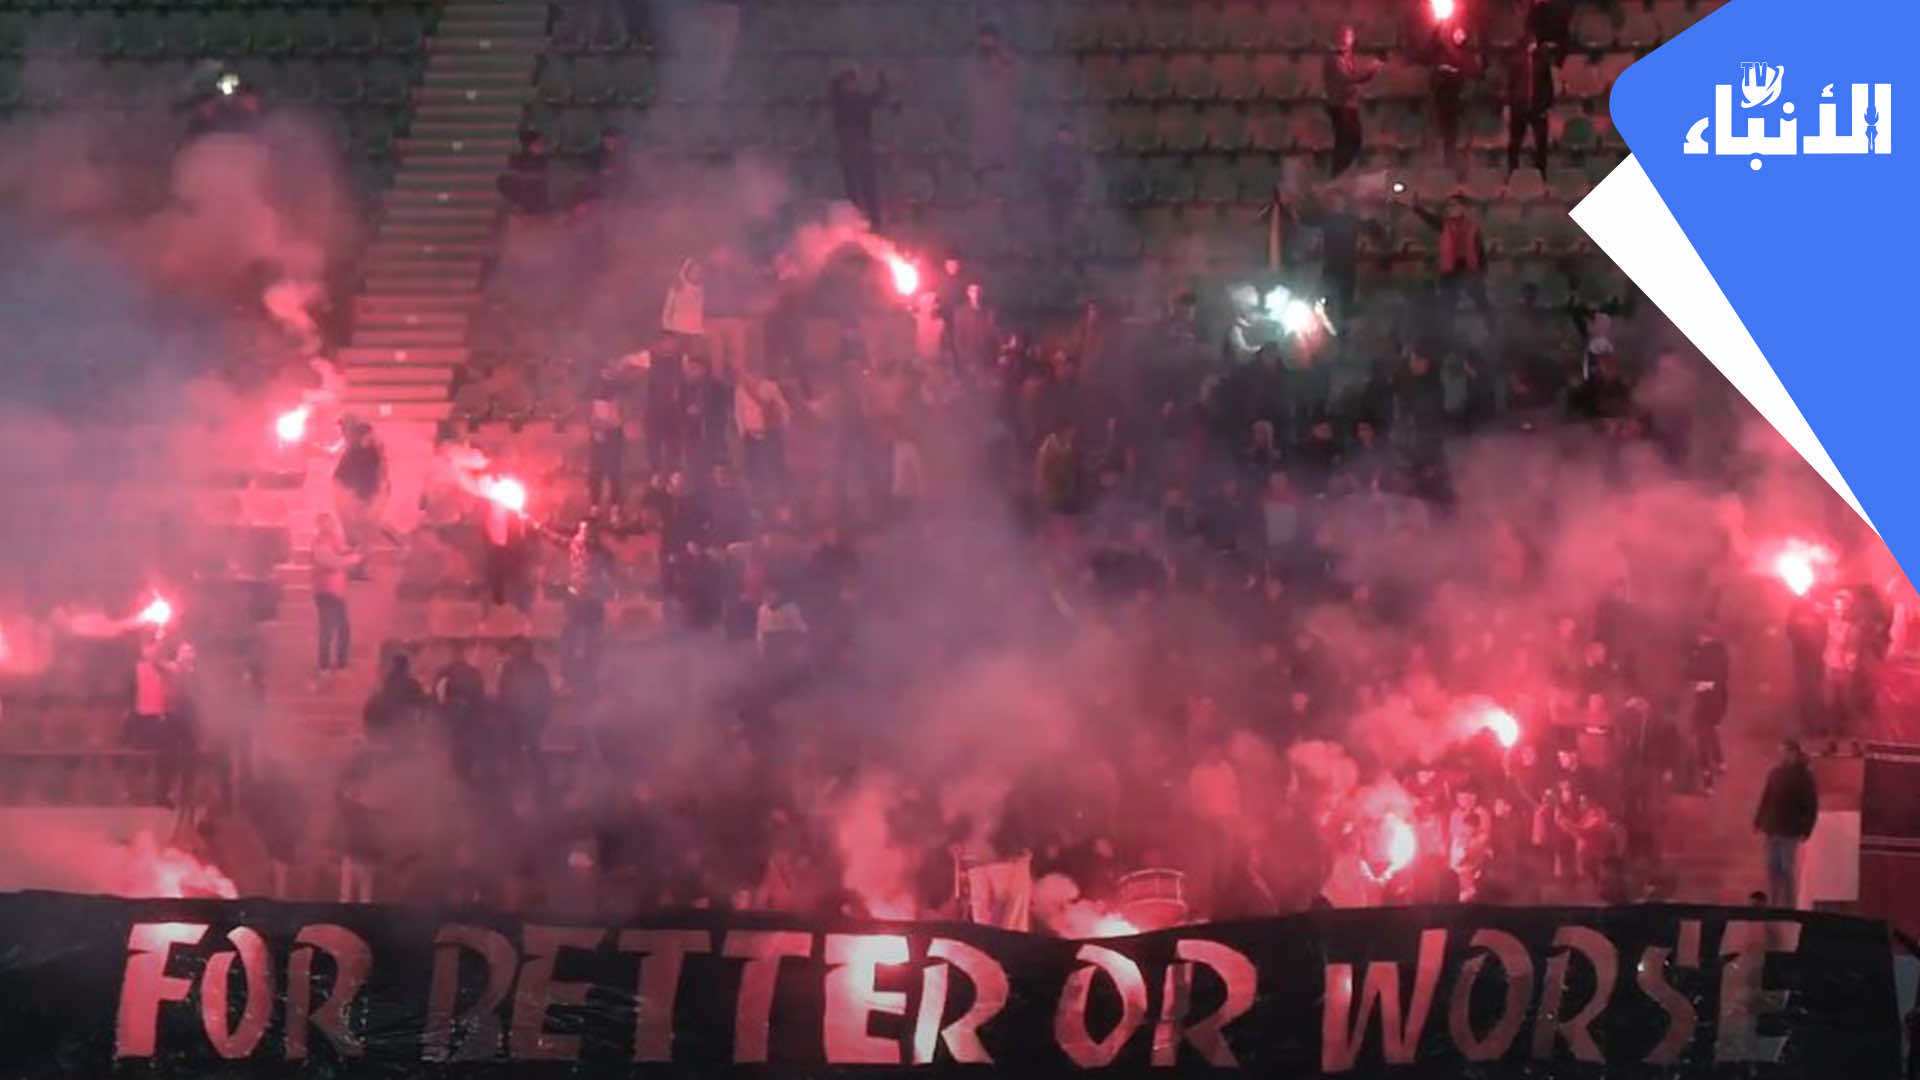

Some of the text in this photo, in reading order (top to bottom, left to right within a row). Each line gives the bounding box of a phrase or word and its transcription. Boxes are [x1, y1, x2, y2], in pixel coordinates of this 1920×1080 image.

[115, 920, 1802, 1073] FOR BETTER OR WORSE
